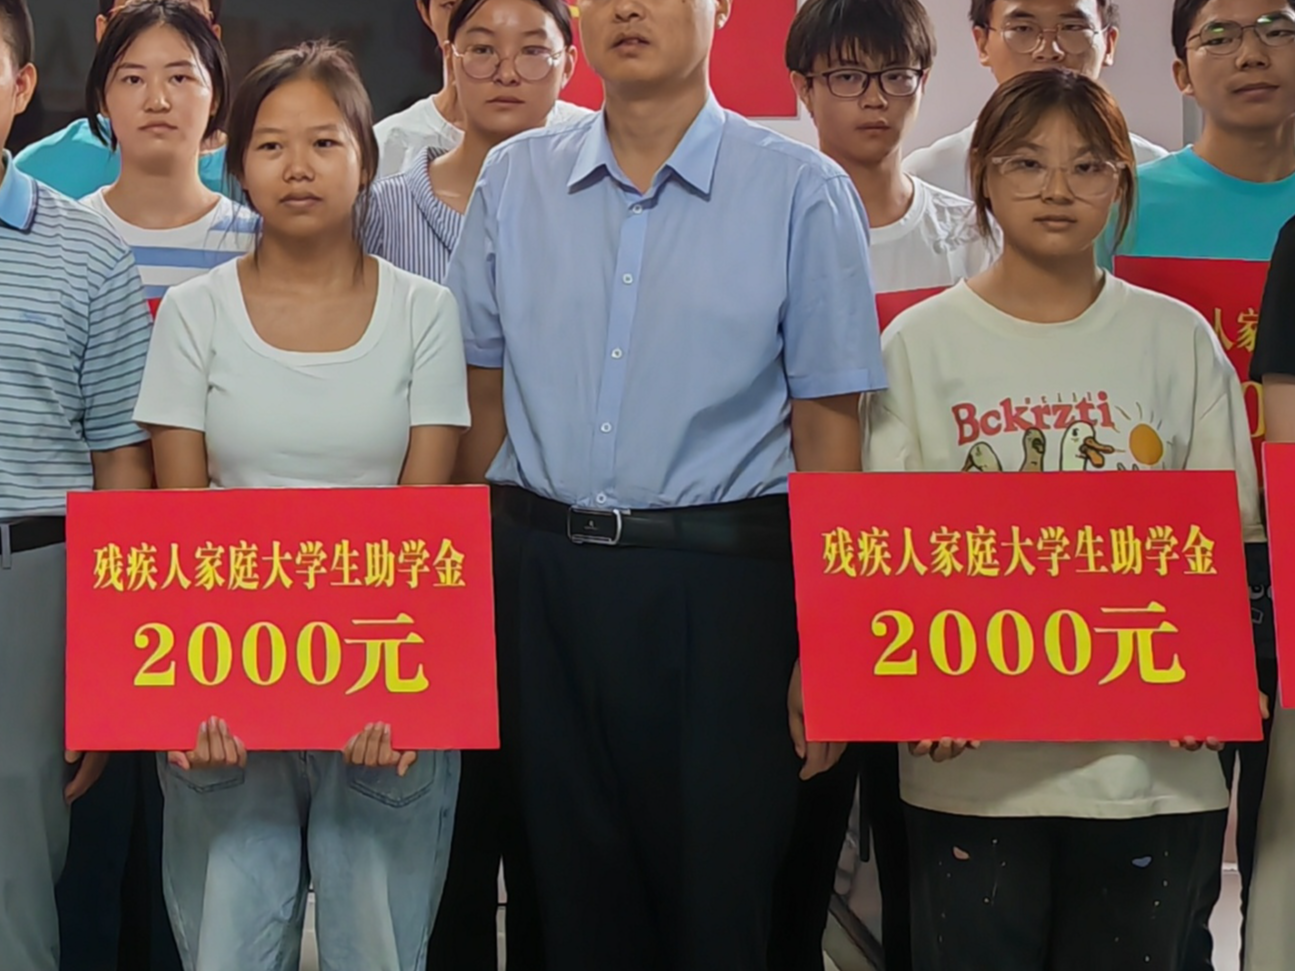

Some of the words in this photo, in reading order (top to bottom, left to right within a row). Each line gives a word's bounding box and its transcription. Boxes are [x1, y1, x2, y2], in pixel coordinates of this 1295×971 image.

[92, 537, 467, 593] 残疾人家庭大学生助学金
[821, 524, 1218, 578] 残疾人家庭大学生助学金
[132, 612, 430, 695] 2000元
[870, 600, 1187, 685] 2000元
